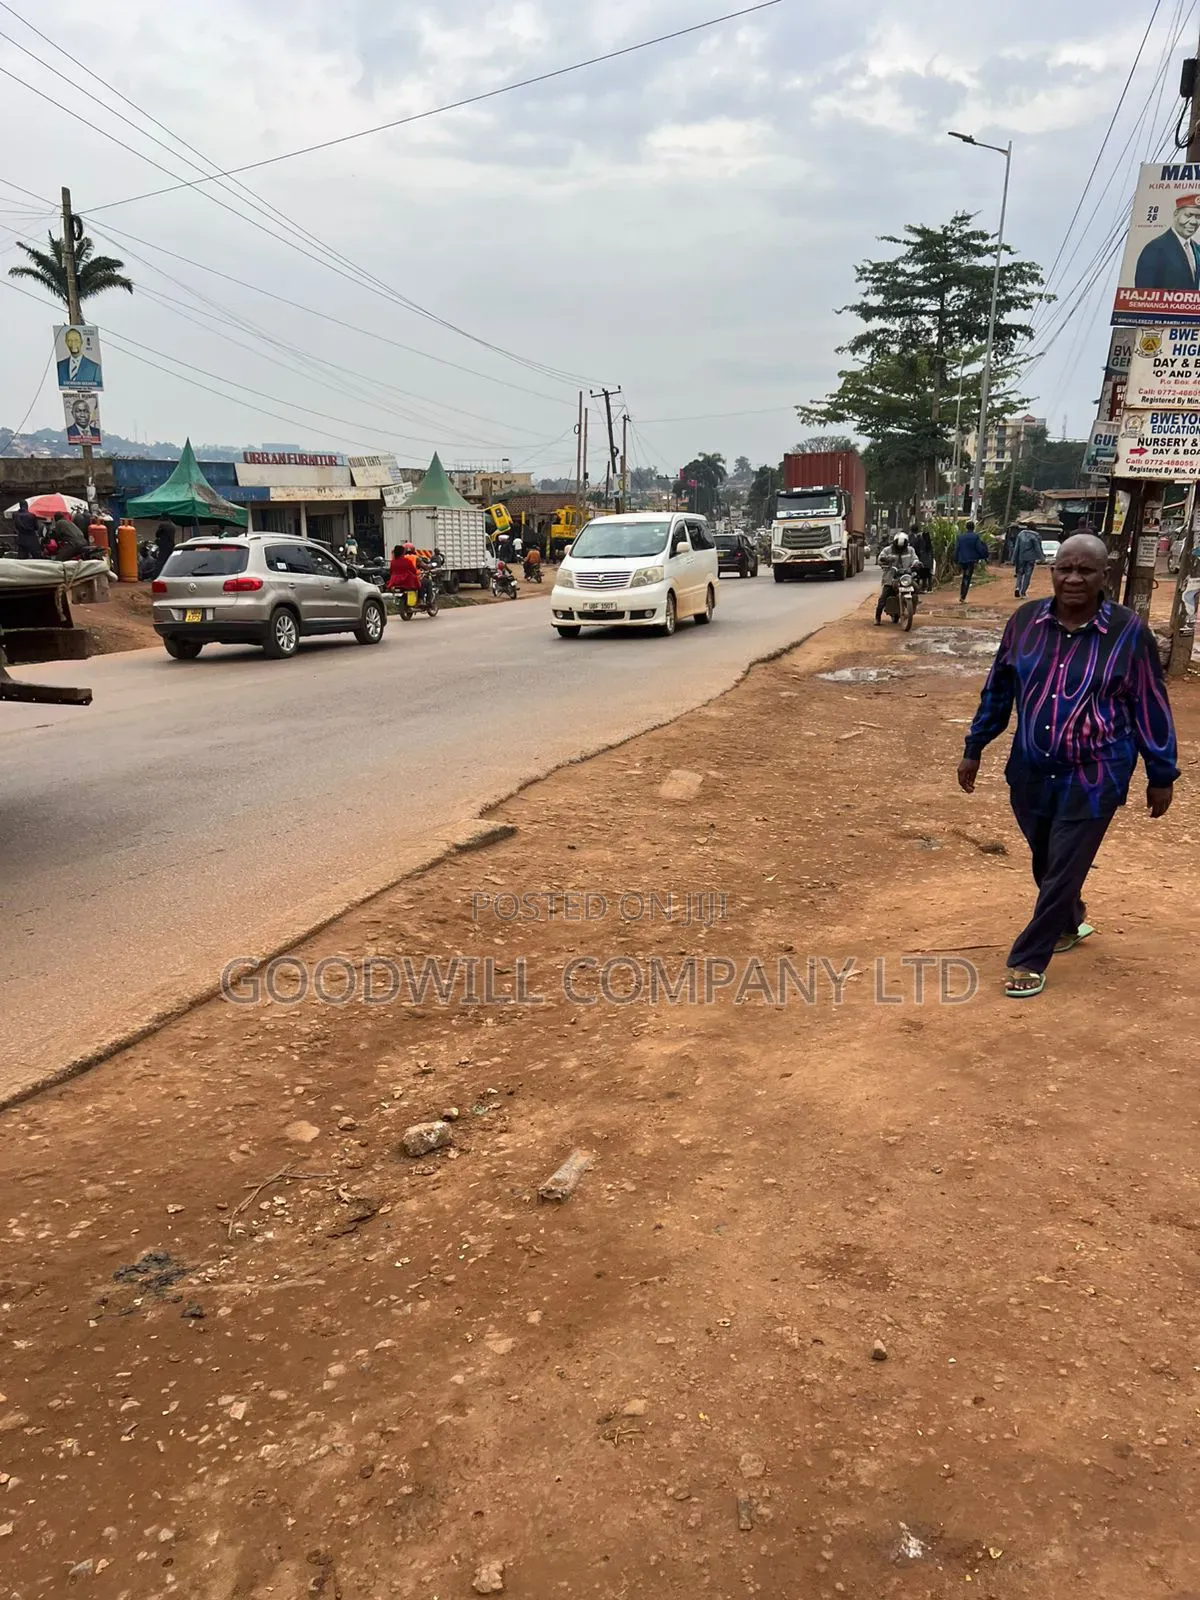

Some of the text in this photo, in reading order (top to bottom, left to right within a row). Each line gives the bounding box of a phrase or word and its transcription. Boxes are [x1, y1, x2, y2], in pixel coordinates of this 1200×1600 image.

[1119, 290, 1161, 301] HAJJI
[1153, 358, 1177, 368] DAY
[1181, 358, 1189, 368] &
[1169, 370, 1192, 378] AND
[1141, 396, 1176, 405] Registered
[1177, 396, 1186, 406] By
[1137, 437, 1198, 447] NURSERY &
[1128, 465, 1163, 474] Registered
[1164, 466, 1172, 475] By
